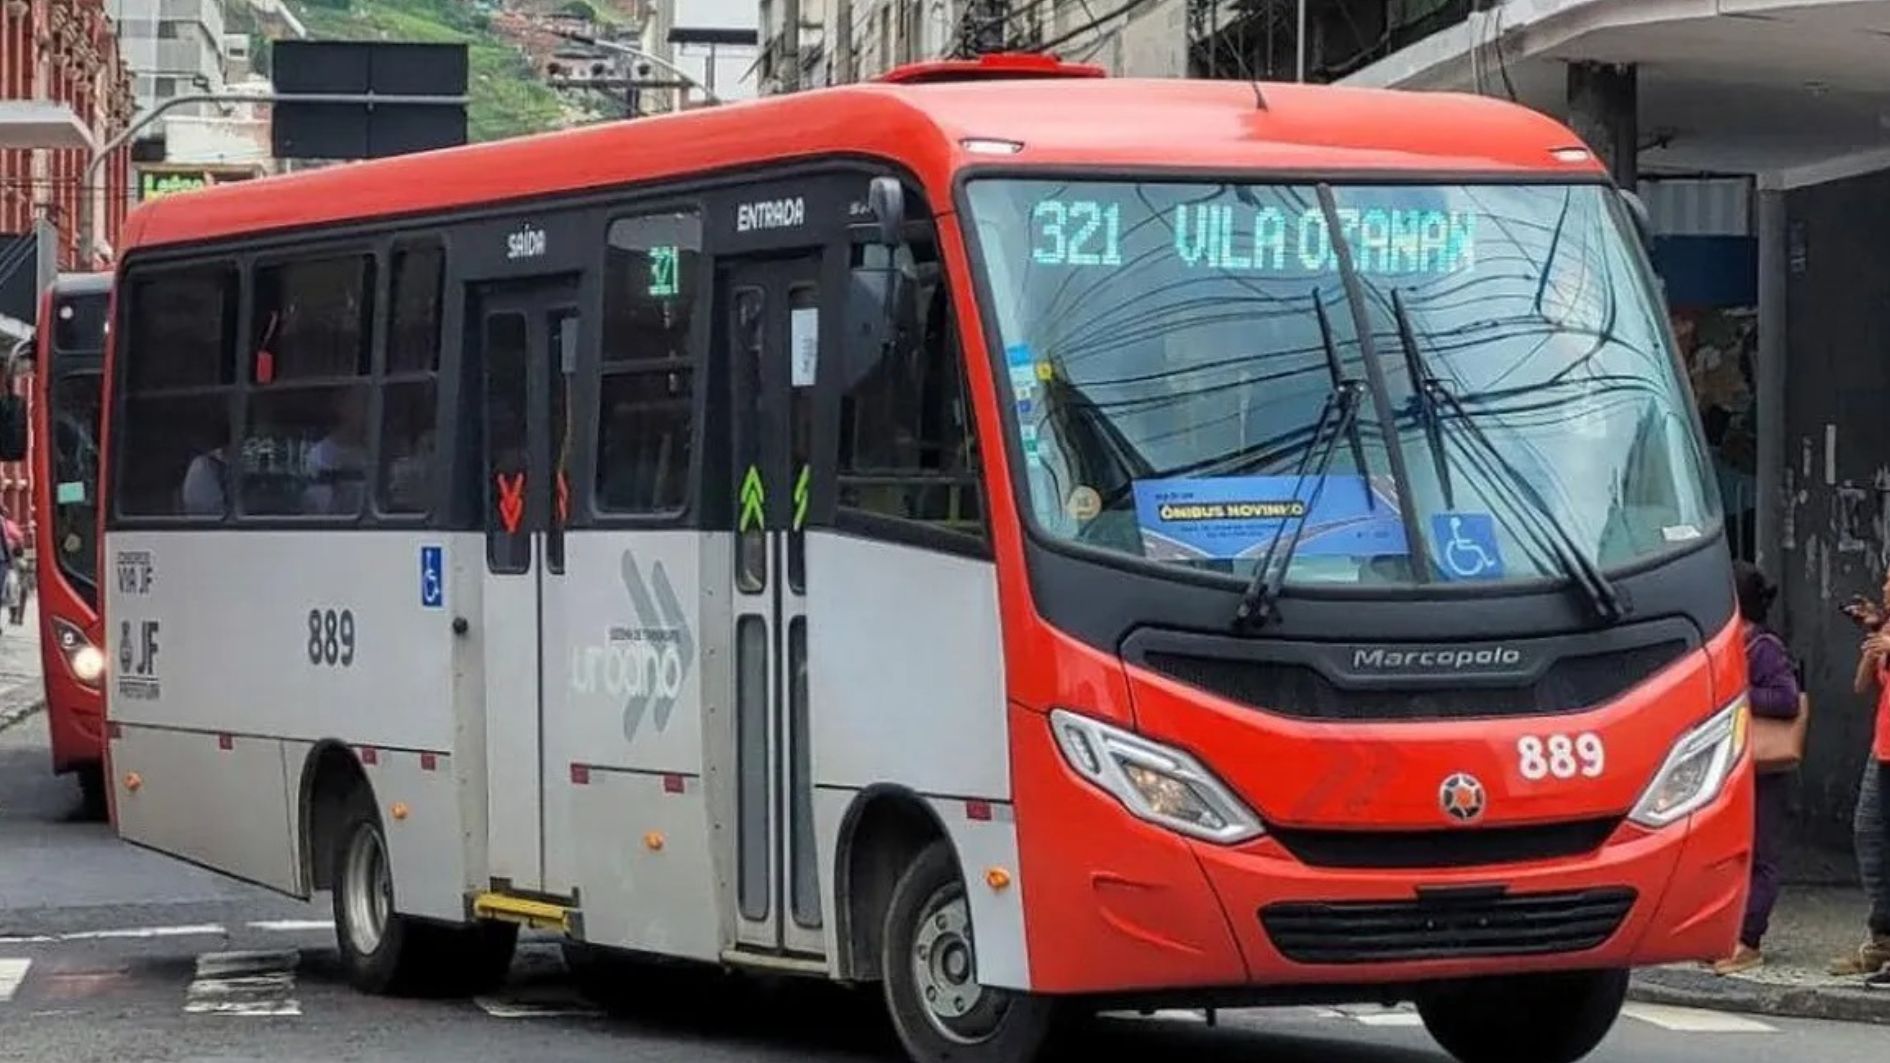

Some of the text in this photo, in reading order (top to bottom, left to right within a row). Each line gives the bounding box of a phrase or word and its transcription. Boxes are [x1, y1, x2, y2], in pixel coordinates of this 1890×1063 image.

[737, 197, 805, 232] ENTRADA
[1032, 200, 1122, 266] 321
[1174, 203, 1286, 268] VILA
[507, 223, 547, 259] SAÍDA
[1161, 503, 1225, 520] ÔNIBUS
[136, 620, 160, 676] JF
[308, 607, 356, 668] 889
[1353, 647, 1521, 669] Marcopolo
[572, 624, 682, 700] urbano
[1516, 732, 1606, 780] 889
